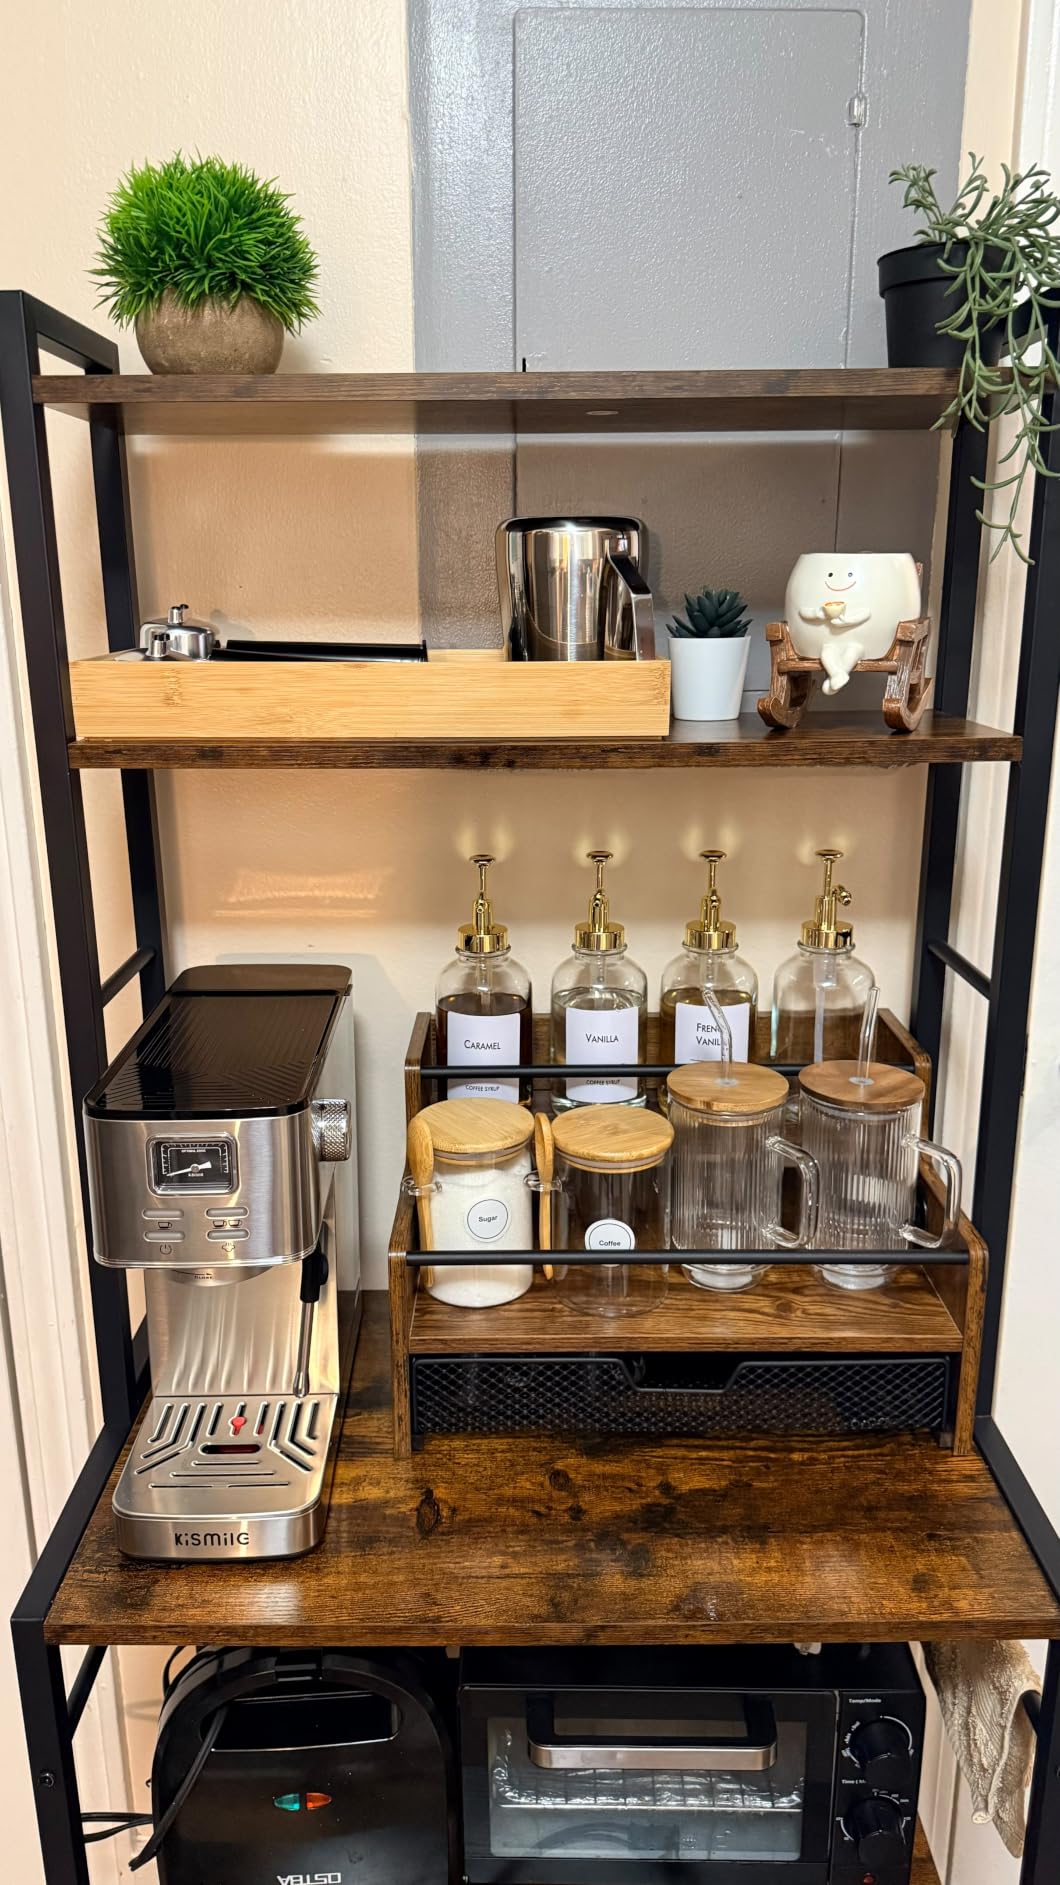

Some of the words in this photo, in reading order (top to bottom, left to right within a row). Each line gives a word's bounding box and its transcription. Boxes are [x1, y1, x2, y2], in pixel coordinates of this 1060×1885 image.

[696, 1022, 722, 1033] FREN
[585, 1033, 619, 1043] VANILLA
[695, 1035, 721, 1046] VANIL
[463, 1039, 501, 1050] CARAMEL
[478, 1215, 498, 1223] Sugar
[598, 1239, 621, 1247] Coffee
